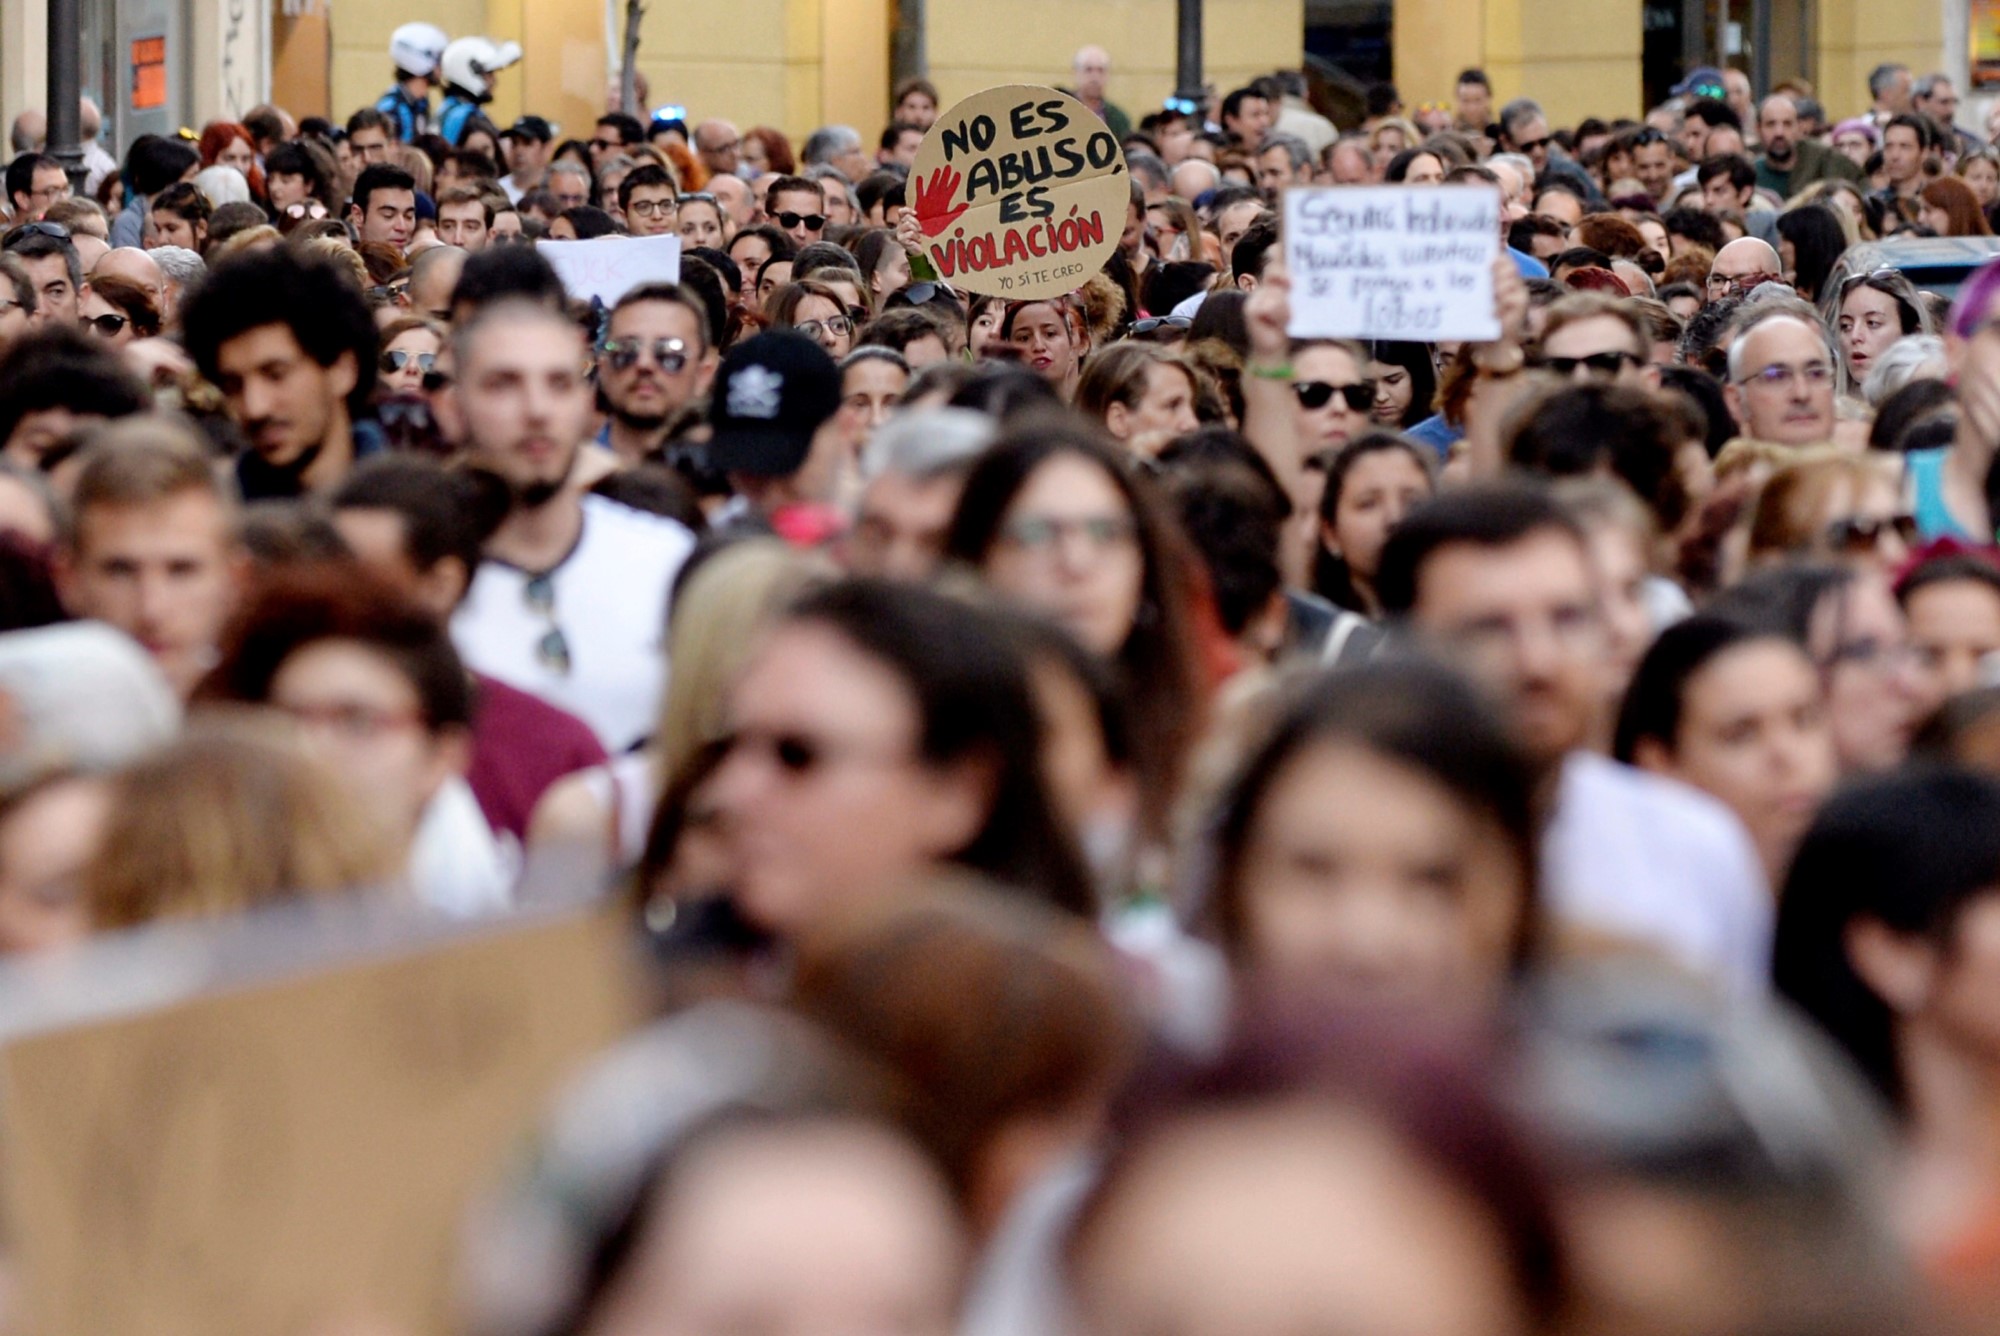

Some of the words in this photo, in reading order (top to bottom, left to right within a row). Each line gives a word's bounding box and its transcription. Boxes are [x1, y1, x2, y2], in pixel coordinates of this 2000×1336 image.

[942, 115, 996, 162] NO
[1010, 101, 1069, 139] ES
[966, 132, 1123, 201] ABUSO,
[999, 186, 1055, 224] ES
[998, 276, 1014, 290] YO
[1032, 270, 1050, 285] TE
[1053, 263, 1084, 280] CREO
